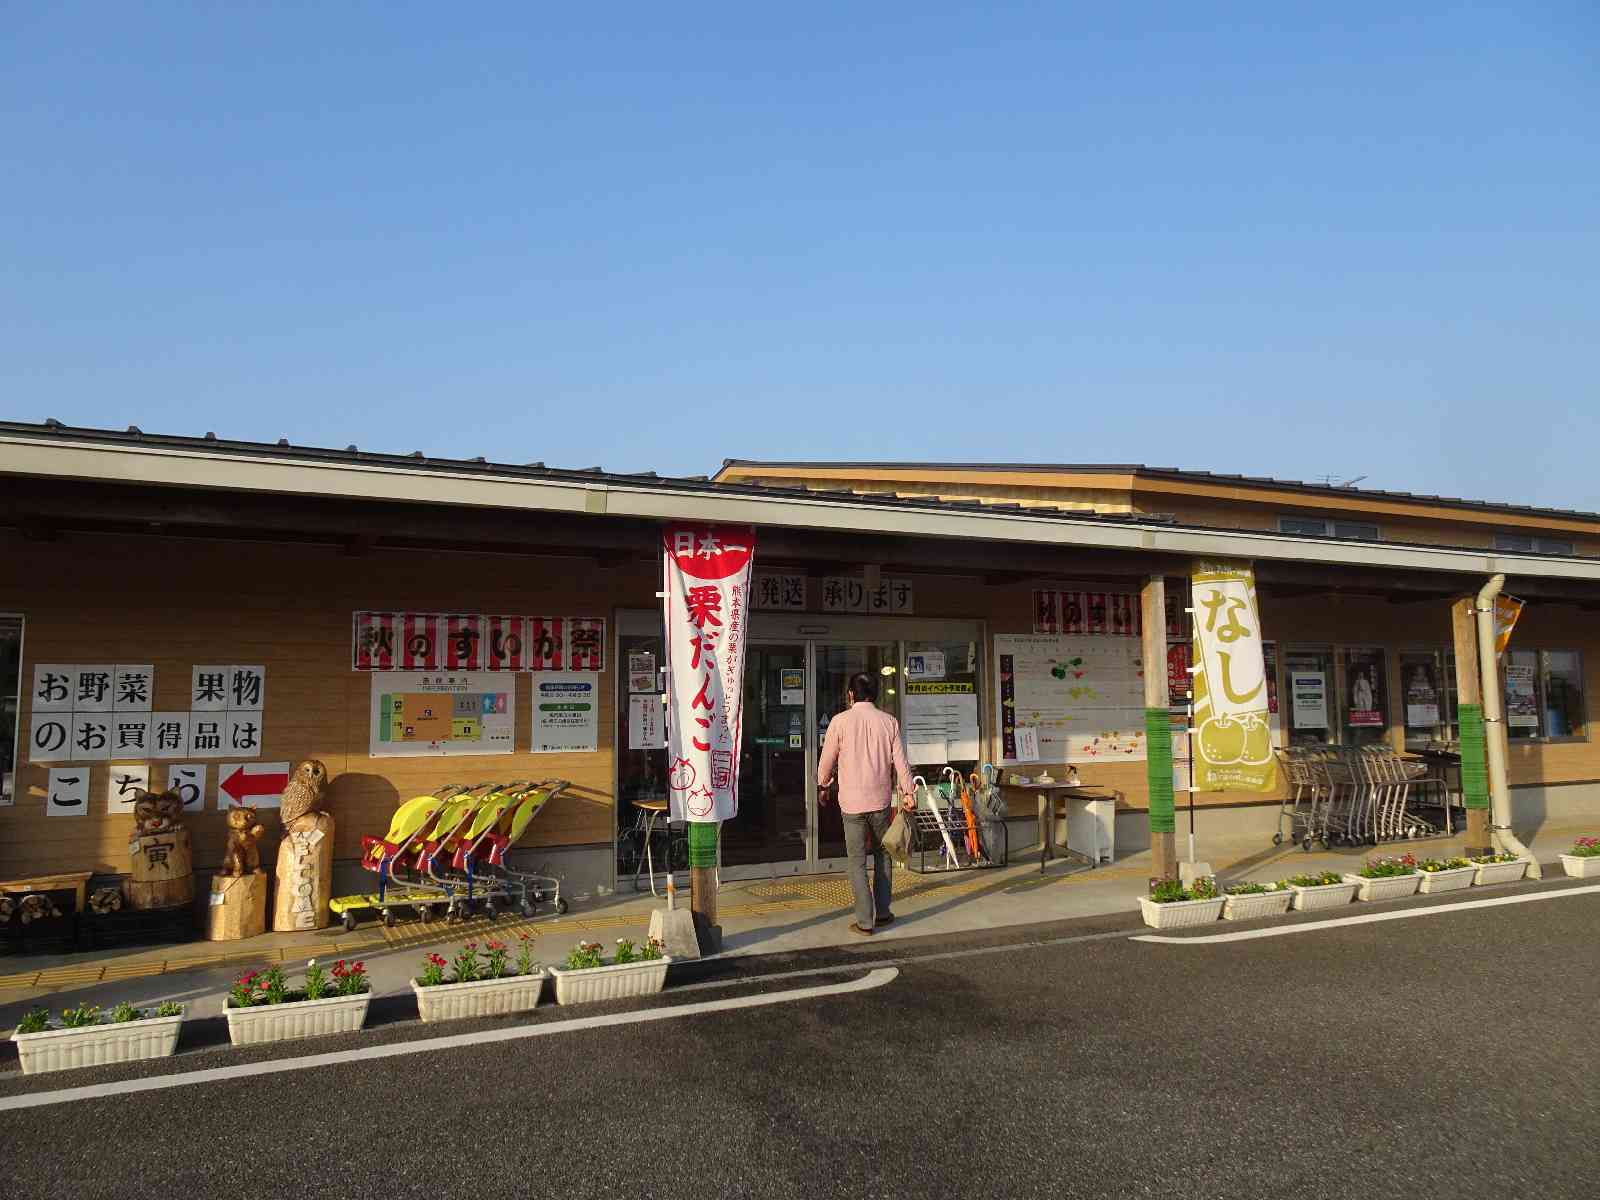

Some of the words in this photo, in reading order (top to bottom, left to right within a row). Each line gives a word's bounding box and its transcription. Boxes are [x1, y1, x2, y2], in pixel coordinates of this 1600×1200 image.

[674, 531, 748, 560] 日本一
[752, 576, 804, 606] 発送
[824, 579, 912, 609] 承ります
[363, 624, 600, 661] 秋のすいか祭
[1201, 588, 1265, 705] なし
[684, 584, 724, 752] 栗だんご
[38, 672, 149, 704] お野菜
[195, 670, 261, 706] 果物
[35, 721, 258, 752] のお買得品は
[52, 769, 201, 807] こちら
[143, 839, 175, 871] 寅
